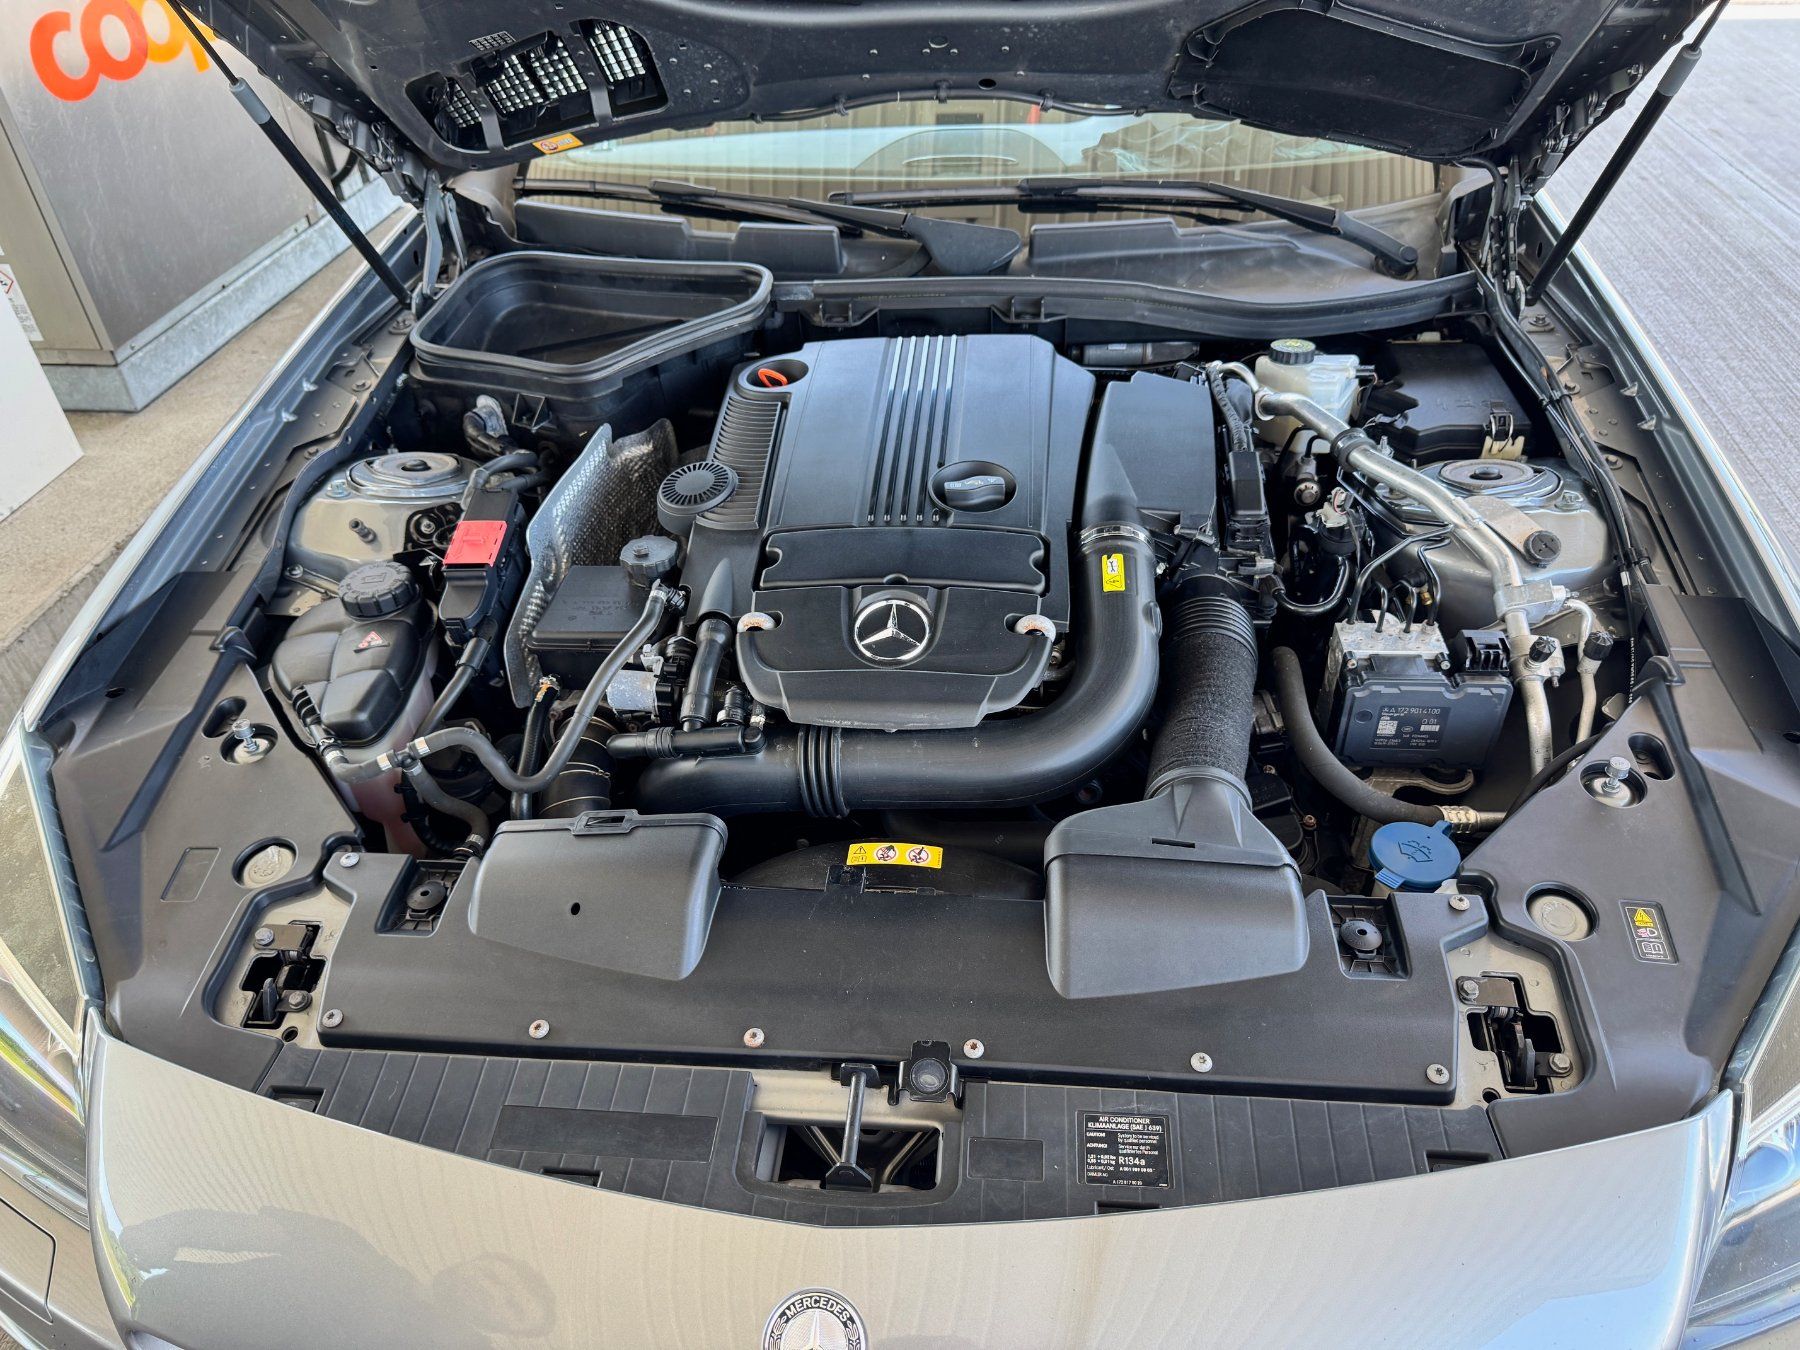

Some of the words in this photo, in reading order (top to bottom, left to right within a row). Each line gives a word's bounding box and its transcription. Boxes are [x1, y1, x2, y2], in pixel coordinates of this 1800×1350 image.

[1088, 1122, 1129, 1130] KLIMAANLAGE
[1118, 1156, 1146, 1166] R134a
[785, 1296, 850, 1321] MERCEDES
